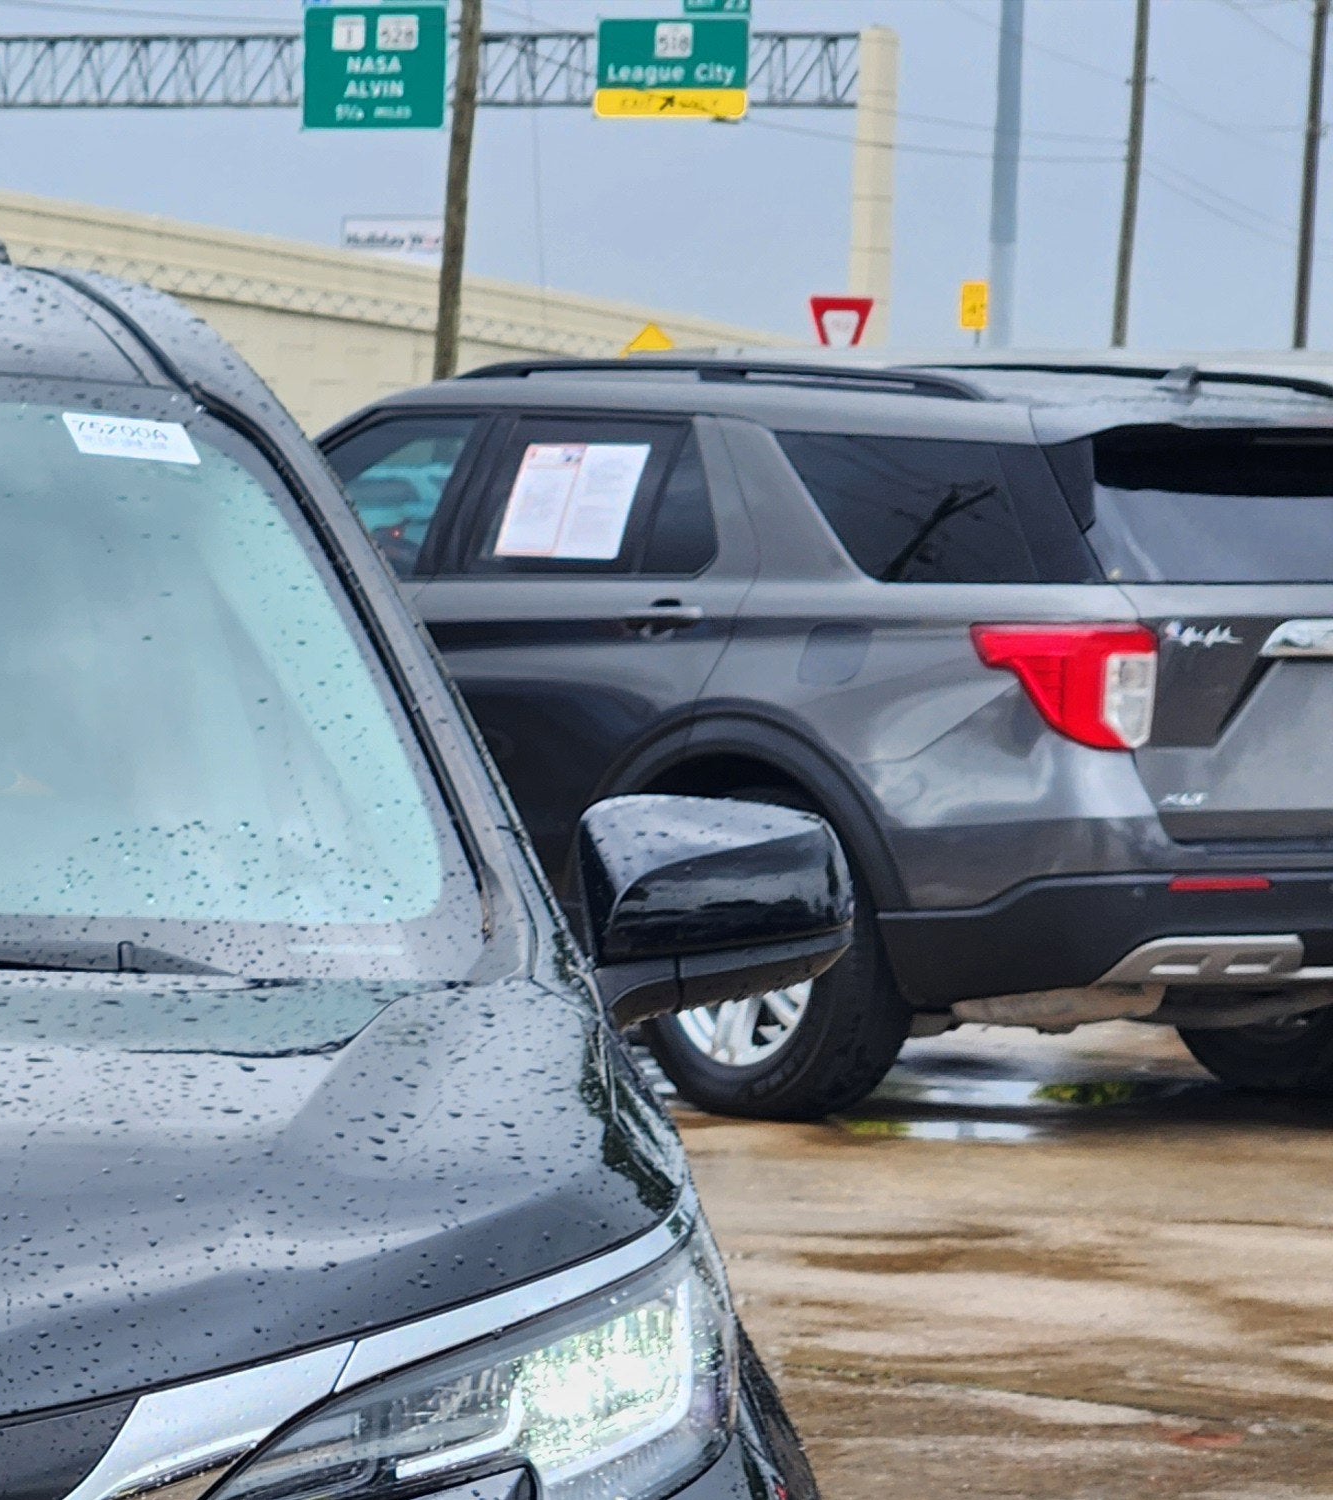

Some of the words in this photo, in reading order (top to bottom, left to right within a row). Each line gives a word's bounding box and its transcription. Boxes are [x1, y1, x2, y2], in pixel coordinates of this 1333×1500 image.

[345, 55, 402, 75] NASA
[606, 62, 685, 86] League
[693, 62, 736, 86] City
[343, 79, 405, 99] ALVIN
